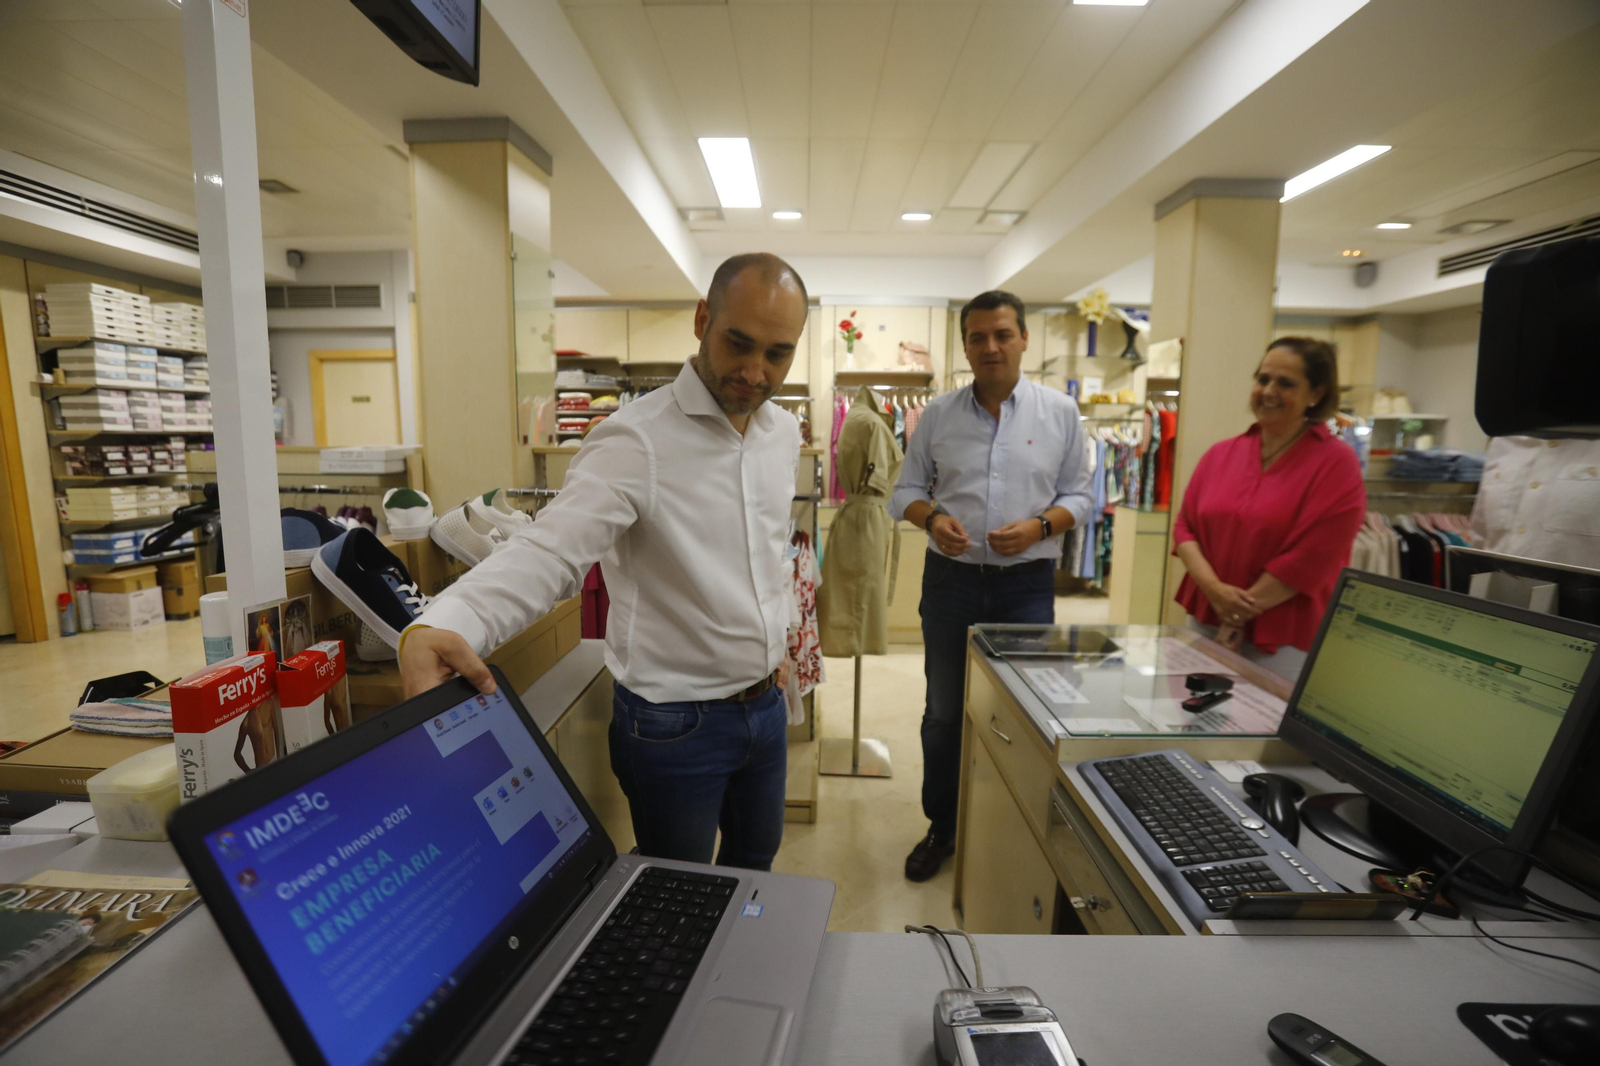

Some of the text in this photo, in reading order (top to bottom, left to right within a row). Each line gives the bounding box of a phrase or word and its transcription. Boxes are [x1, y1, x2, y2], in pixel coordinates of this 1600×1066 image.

[217, 667, 267, 706] Ferry's
[214, 712, 230, 725] Hecho
[235, 702, 250, 714] España
[59, 778, 87, 786] YSABE
[180, 748, 199, 799] Ferry's
[275, 863, 328, 900] Crece
[327, 855, 340, 868] e
[337, 823, 386, 860] Innova
[382, 804, 413, 831] 2021
[289, 849, 394, 929] EMPRESA
[304, 843, 442, 956] BENEFICIARIA
